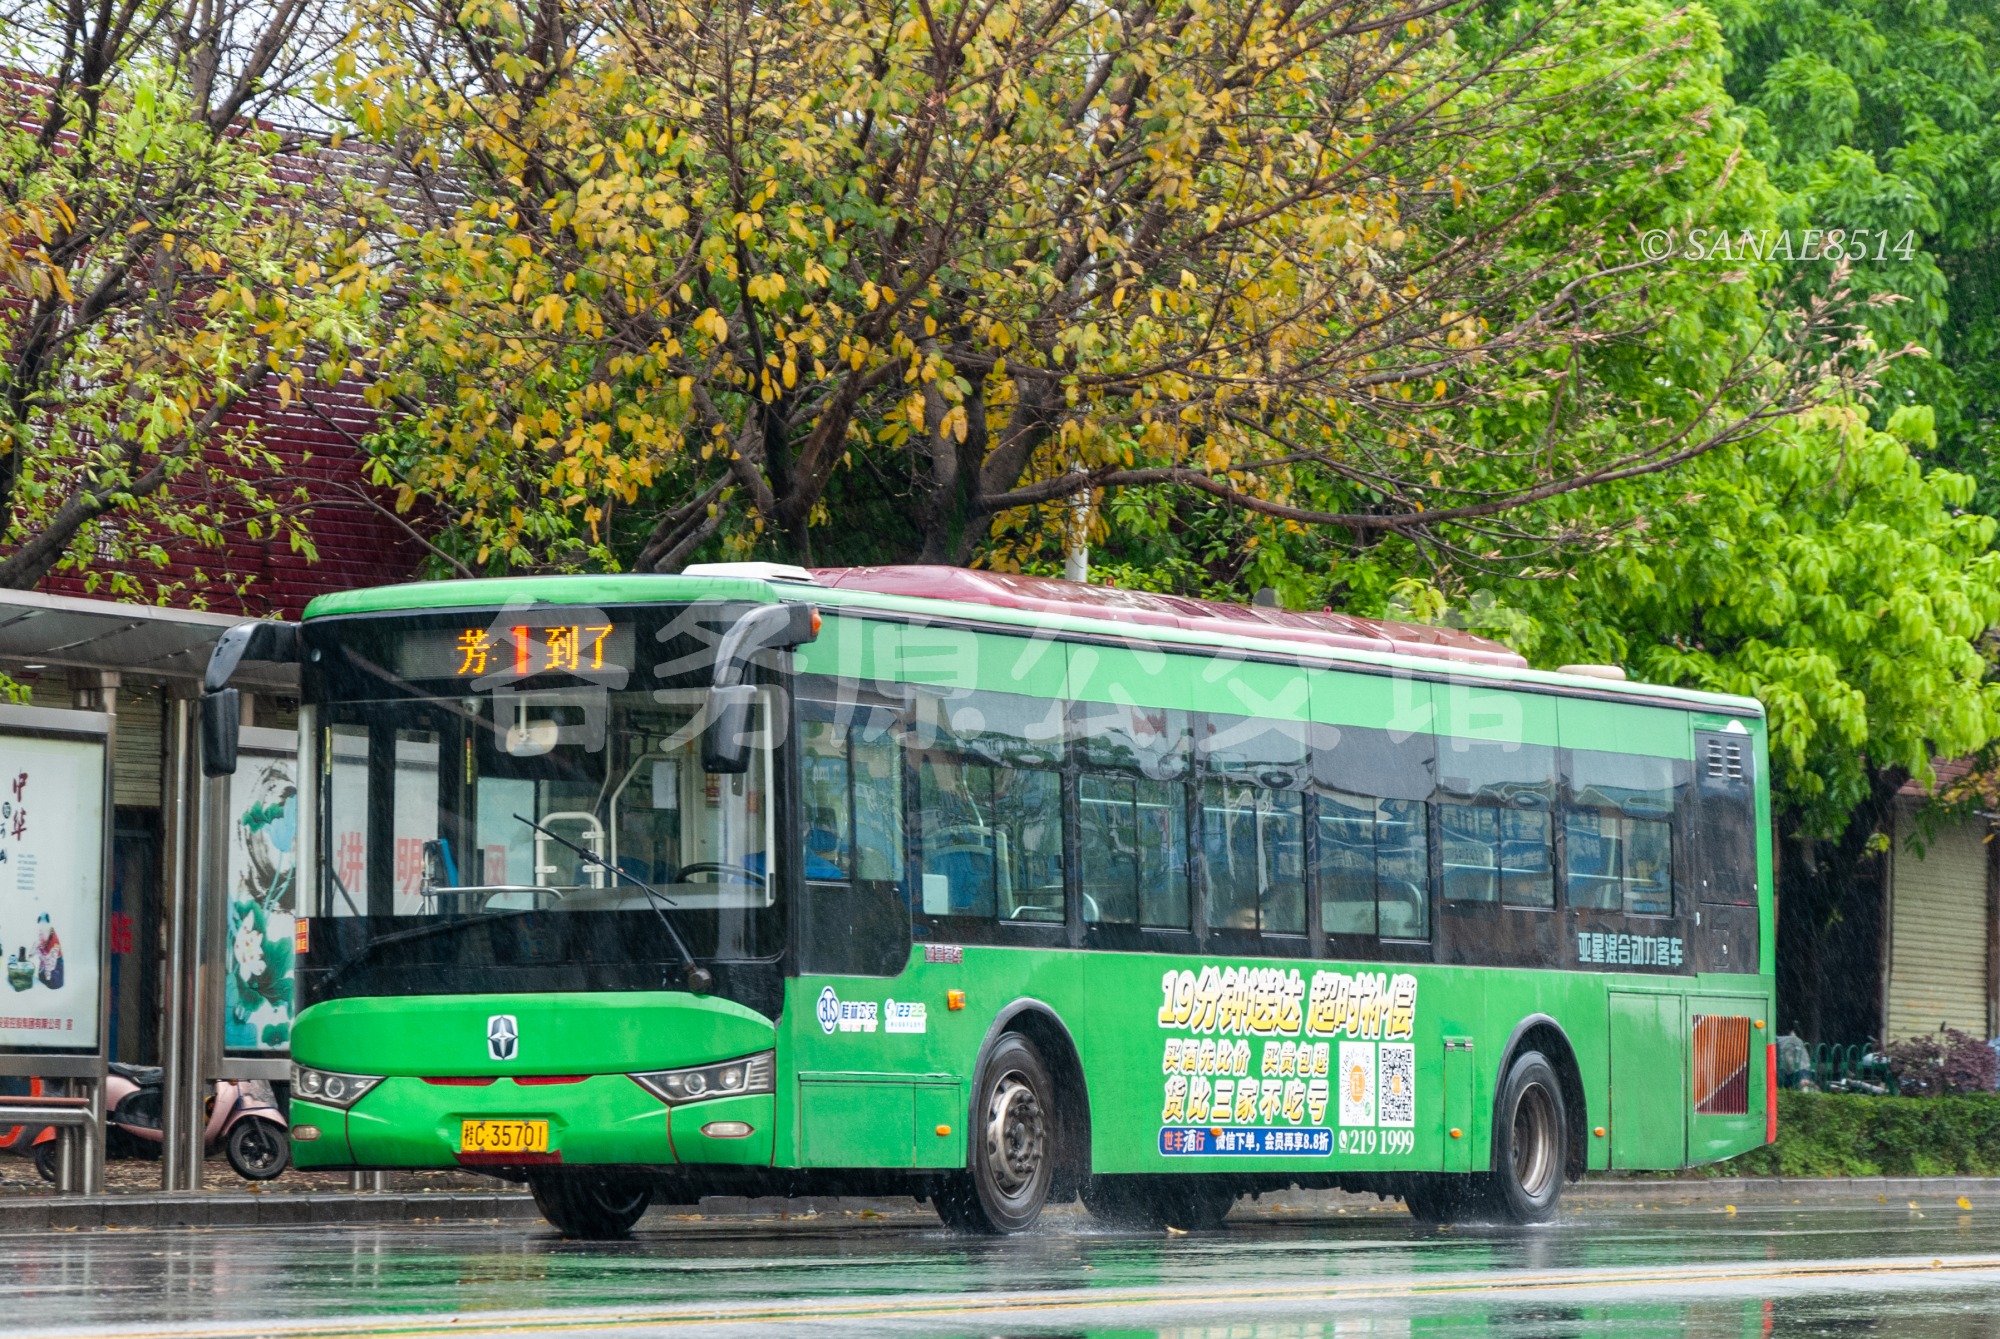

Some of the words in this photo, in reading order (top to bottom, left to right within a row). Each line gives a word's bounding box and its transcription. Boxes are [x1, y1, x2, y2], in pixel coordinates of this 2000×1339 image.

[544, 623, 615, 671] 到了
[1578, 932, 1684, 967] 亚星混合动力客车
[1159, 966, 1304, 1034] 19分钟送达
[1306, 970, 1417, 1040] 超时补偿
[1163, 1039, 1251, 1076] 买酒先比价
[1262, 1041, 1329, 1078] 买贵包退
[1163, 1076, 1329, 1125] 货比三家不吃亏
[1163, 1129, 1206, 1153] 世丰酒行
[1379, 1129, 1415, 1155] 1999
